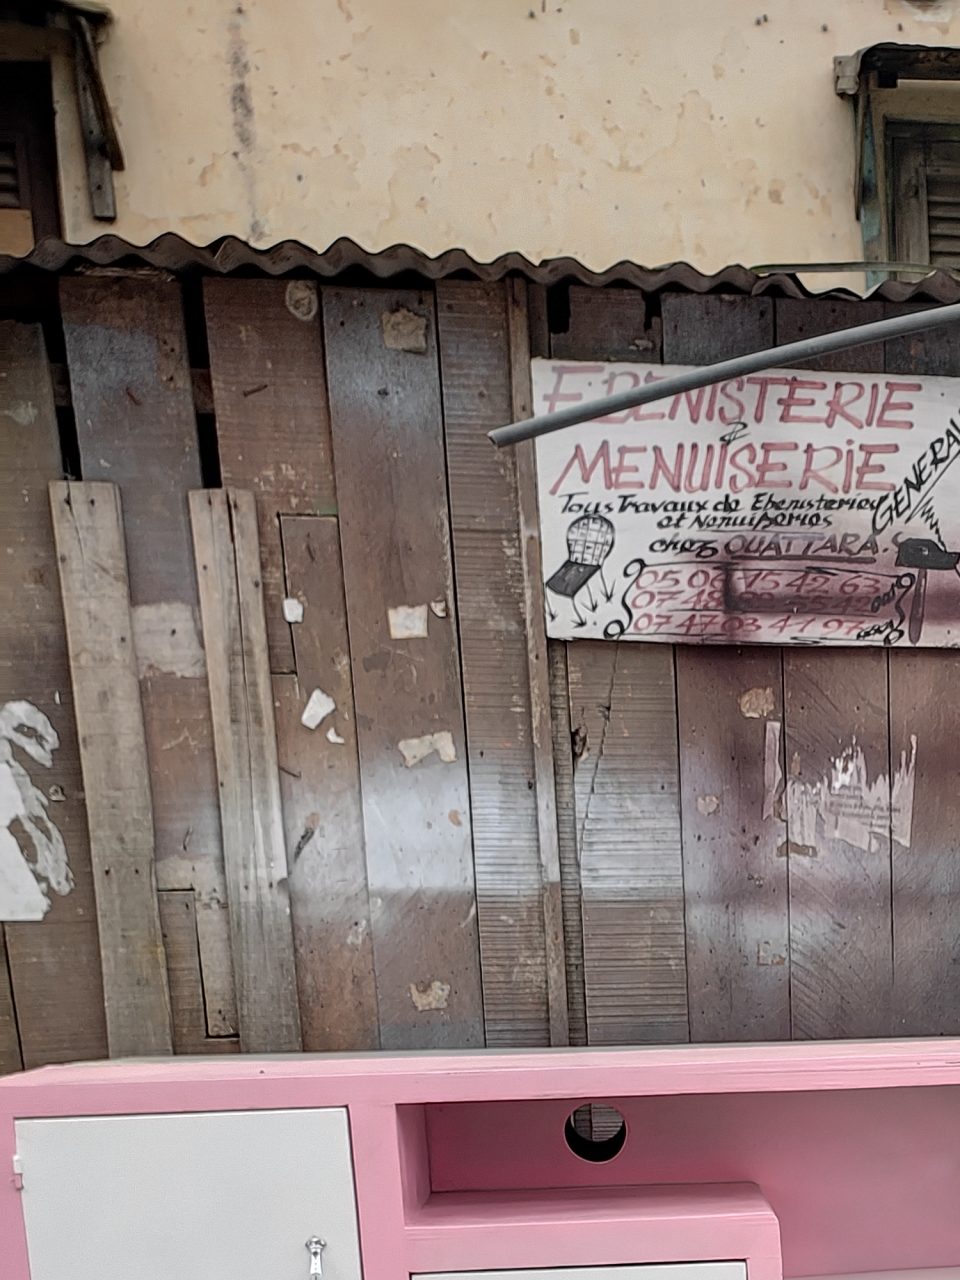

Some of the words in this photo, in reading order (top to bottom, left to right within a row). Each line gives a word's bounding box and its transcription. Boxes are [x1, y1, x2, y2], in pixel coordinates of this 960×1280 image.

[558, 492, 613, 515] Tous
[617, 493, 708, 514] Travaux
[712, 493, 744, 515] de
[635, 569, 681, 590] 05
[785, 570, 830, 595] 42
[838, 574, 881, 596] 63
[631, 589, 684, 609] 07
[633, 612, 674, 633] 07
[675, 612, 721, 634] 47
[720, 615, 763, 633] 03
